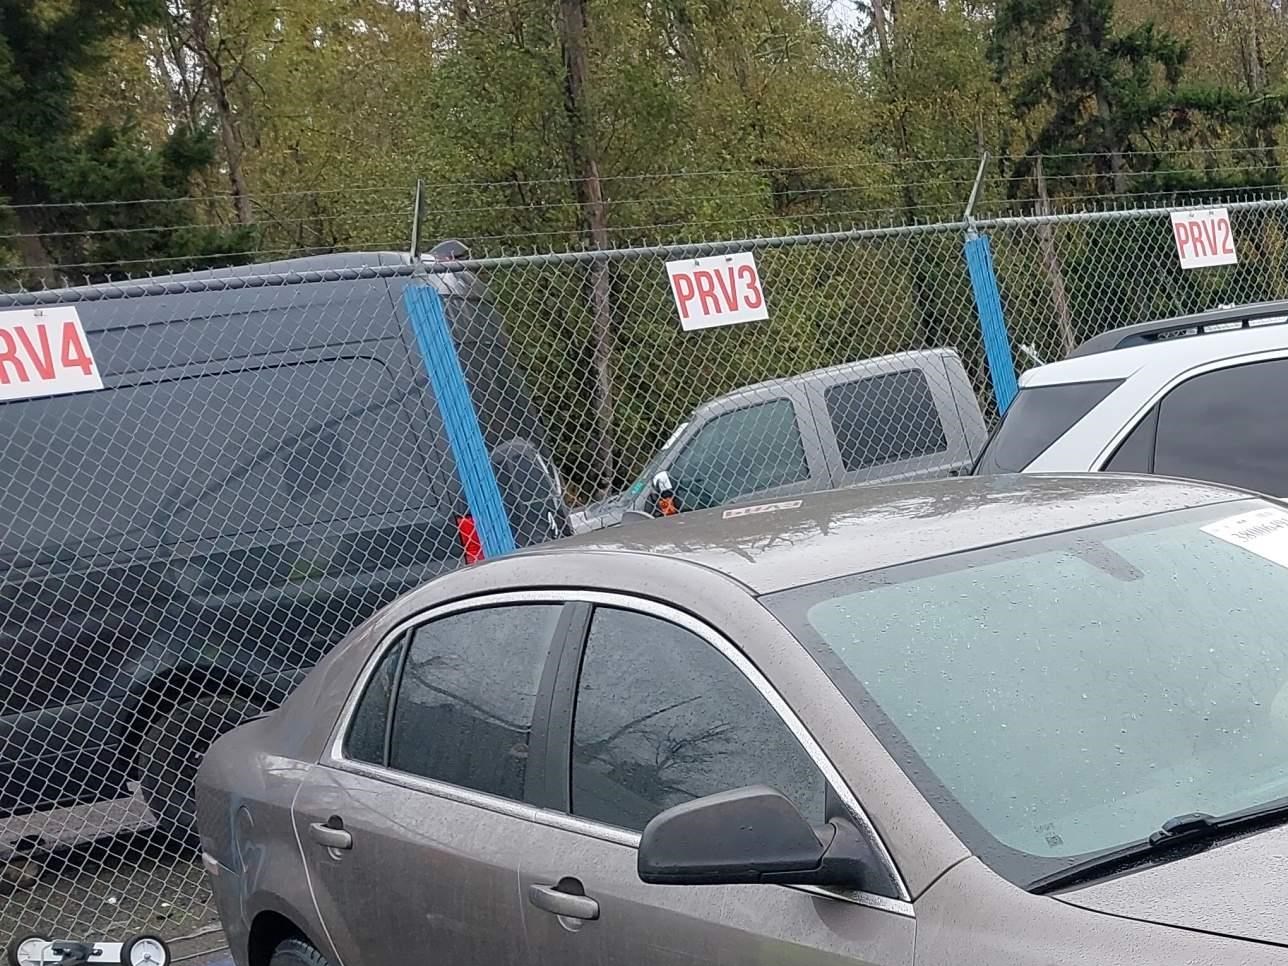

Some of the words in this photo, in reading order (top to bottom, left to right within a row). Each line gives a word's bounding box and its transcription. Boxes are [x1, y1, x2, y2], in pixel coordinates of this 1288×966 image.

[1174, 217, 1234, 259] PRV2
[671, 264, 763, 319] PRV3
[0, 321, 94, 385] RV4
